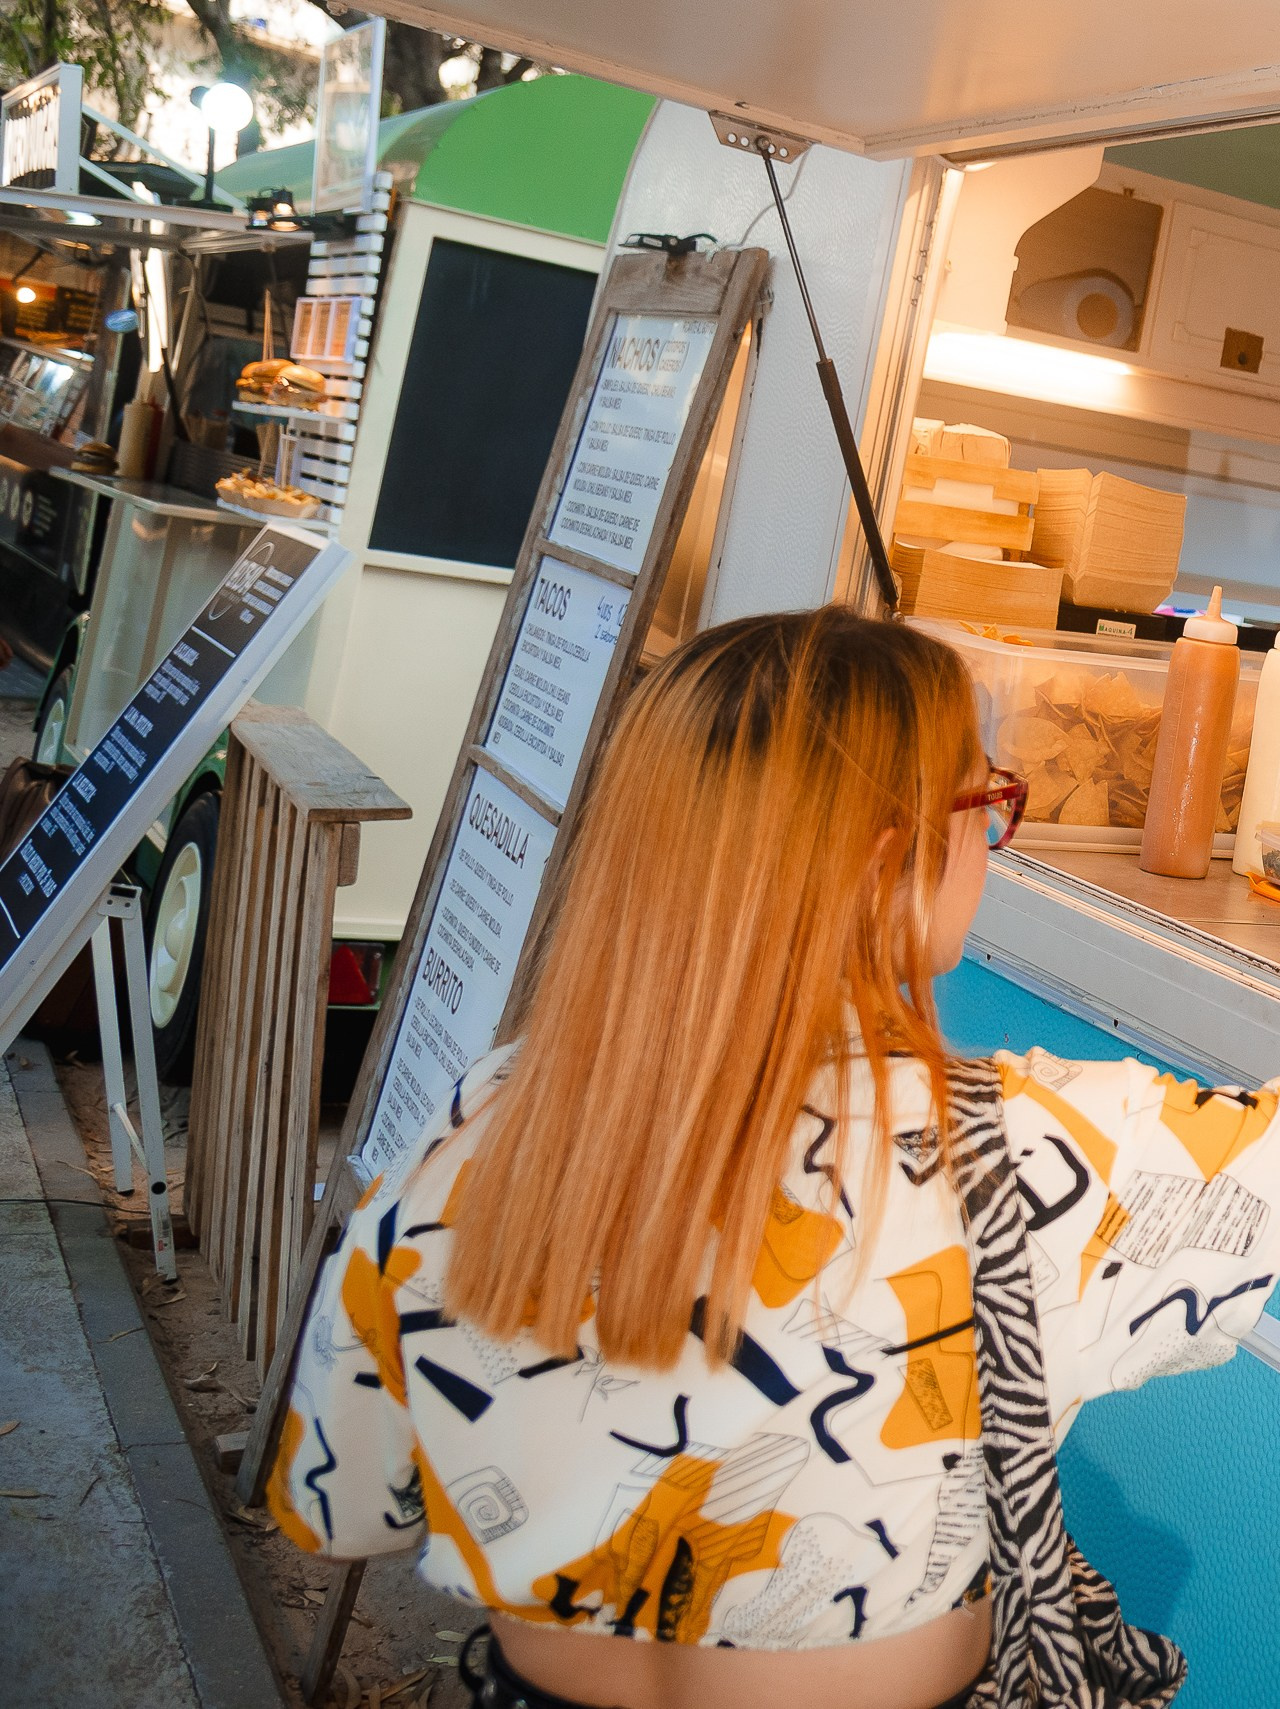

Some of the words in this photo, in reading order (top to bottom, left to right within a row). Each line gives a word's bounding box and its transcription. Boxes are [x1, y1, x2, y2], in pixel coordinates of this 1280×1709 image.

[607, 337, 660, 370] NACHOS
[534, 578, 571, 620] TACOS
[469, 794, 529, 868] QUESADILLA
[422, 947, 463, 1015] BURRITO
